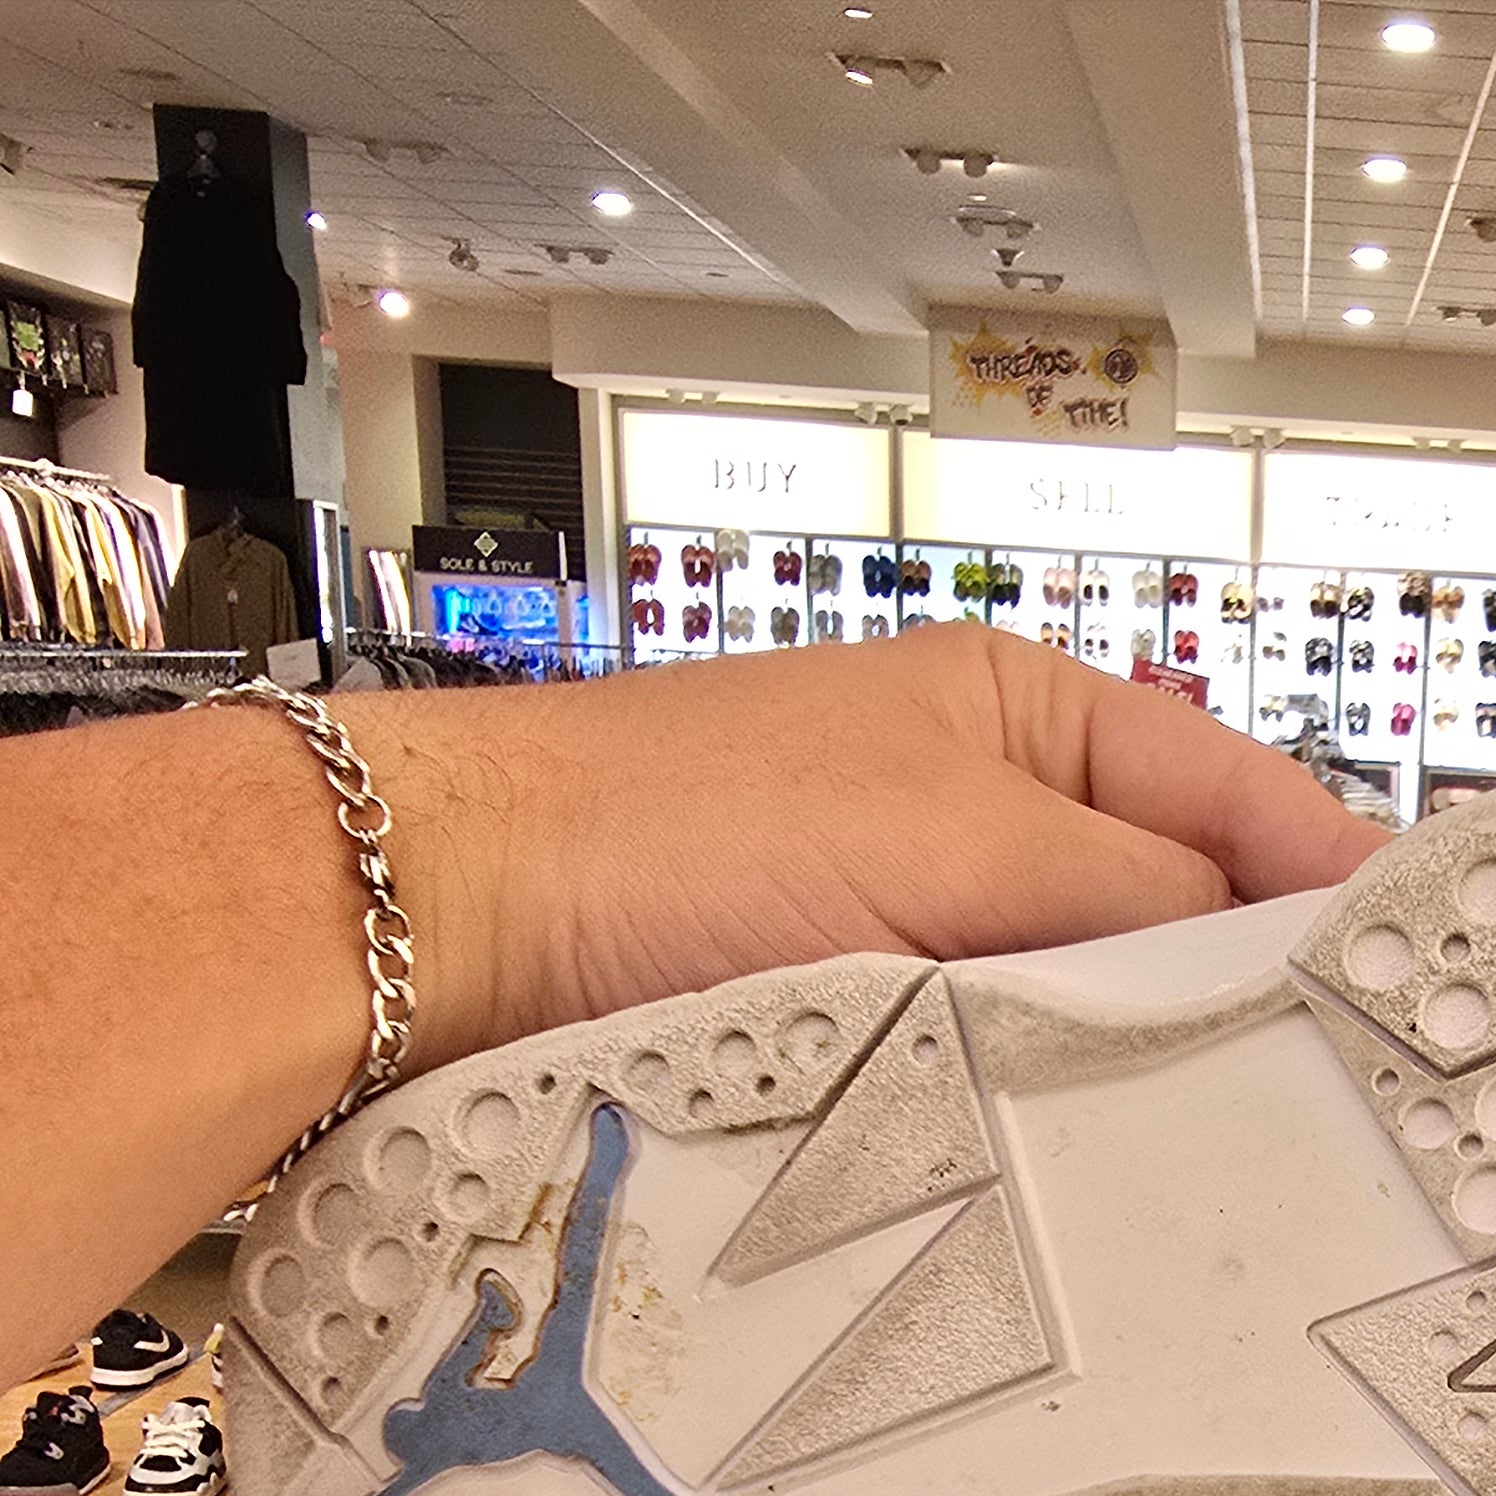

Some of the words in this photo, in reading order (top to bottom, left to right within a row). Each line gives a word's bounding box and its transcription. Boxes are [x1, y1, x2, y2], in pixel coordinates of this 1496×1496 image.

[714, 458, 797, 493] BUY
[440, 557, 475, 571] SOLE
[478, 560, 488, 572] &
[491, 560, 534, 574] STYLE
